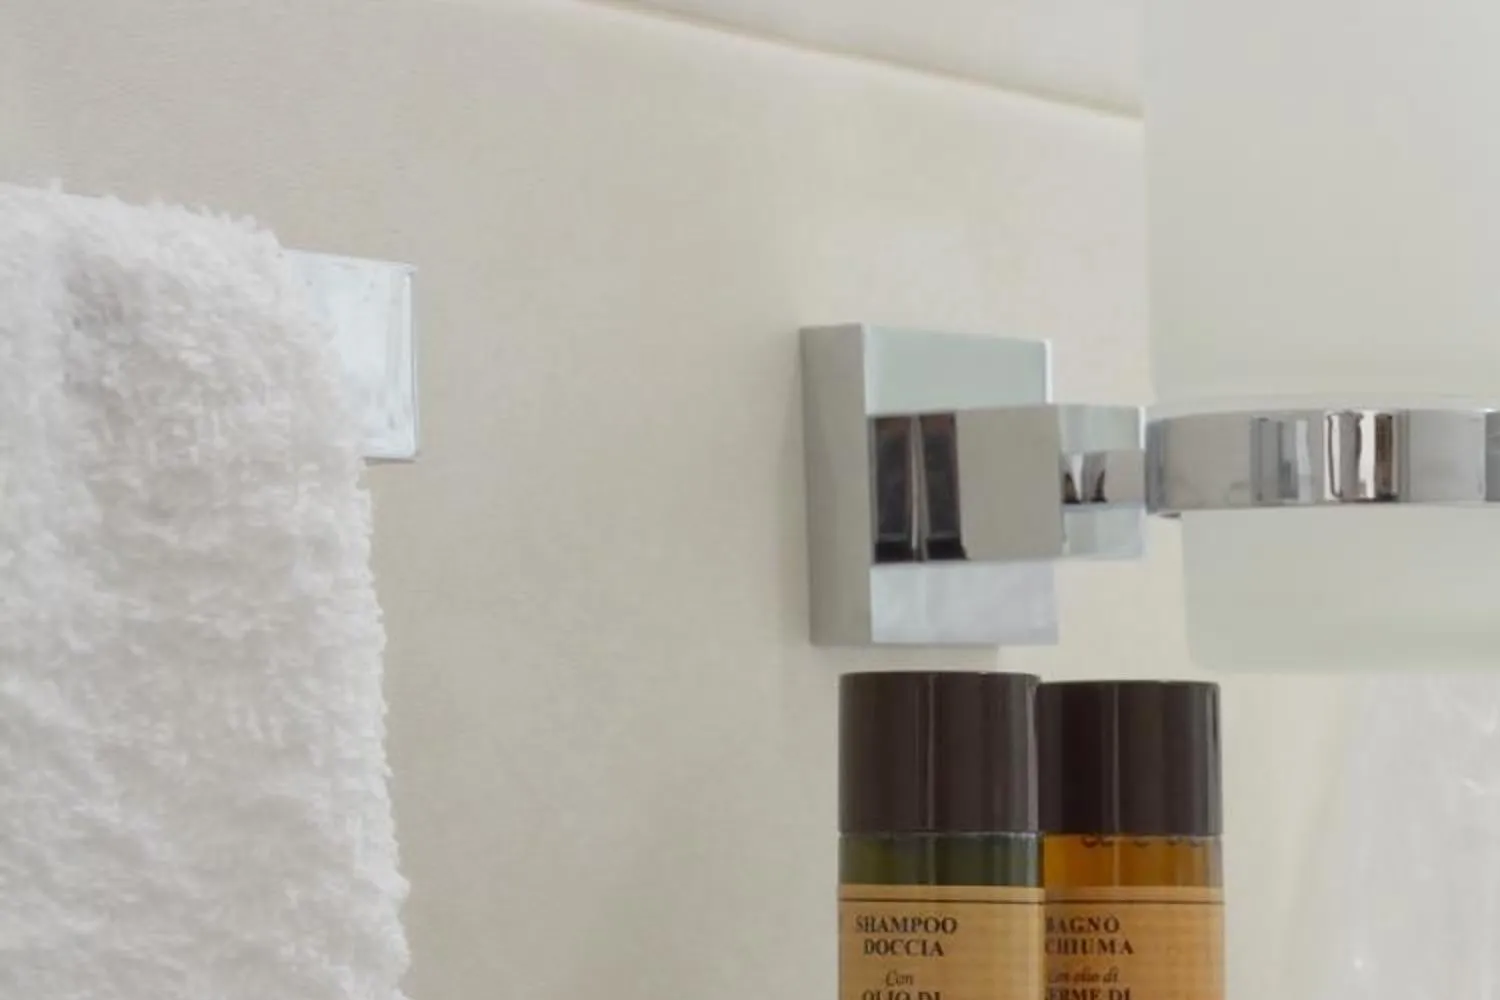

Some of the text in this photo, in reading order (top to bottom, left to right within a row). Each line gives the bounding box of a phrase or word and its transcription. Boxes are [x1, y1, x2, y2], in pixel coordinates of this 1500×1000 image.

[855, 915, 957, 934] SHAMPOO
[864, 938, 944, 957] DOCCIA
[1045, 938, 1134, 955] CHIUMA
[885, 969, 914, 986] Con
